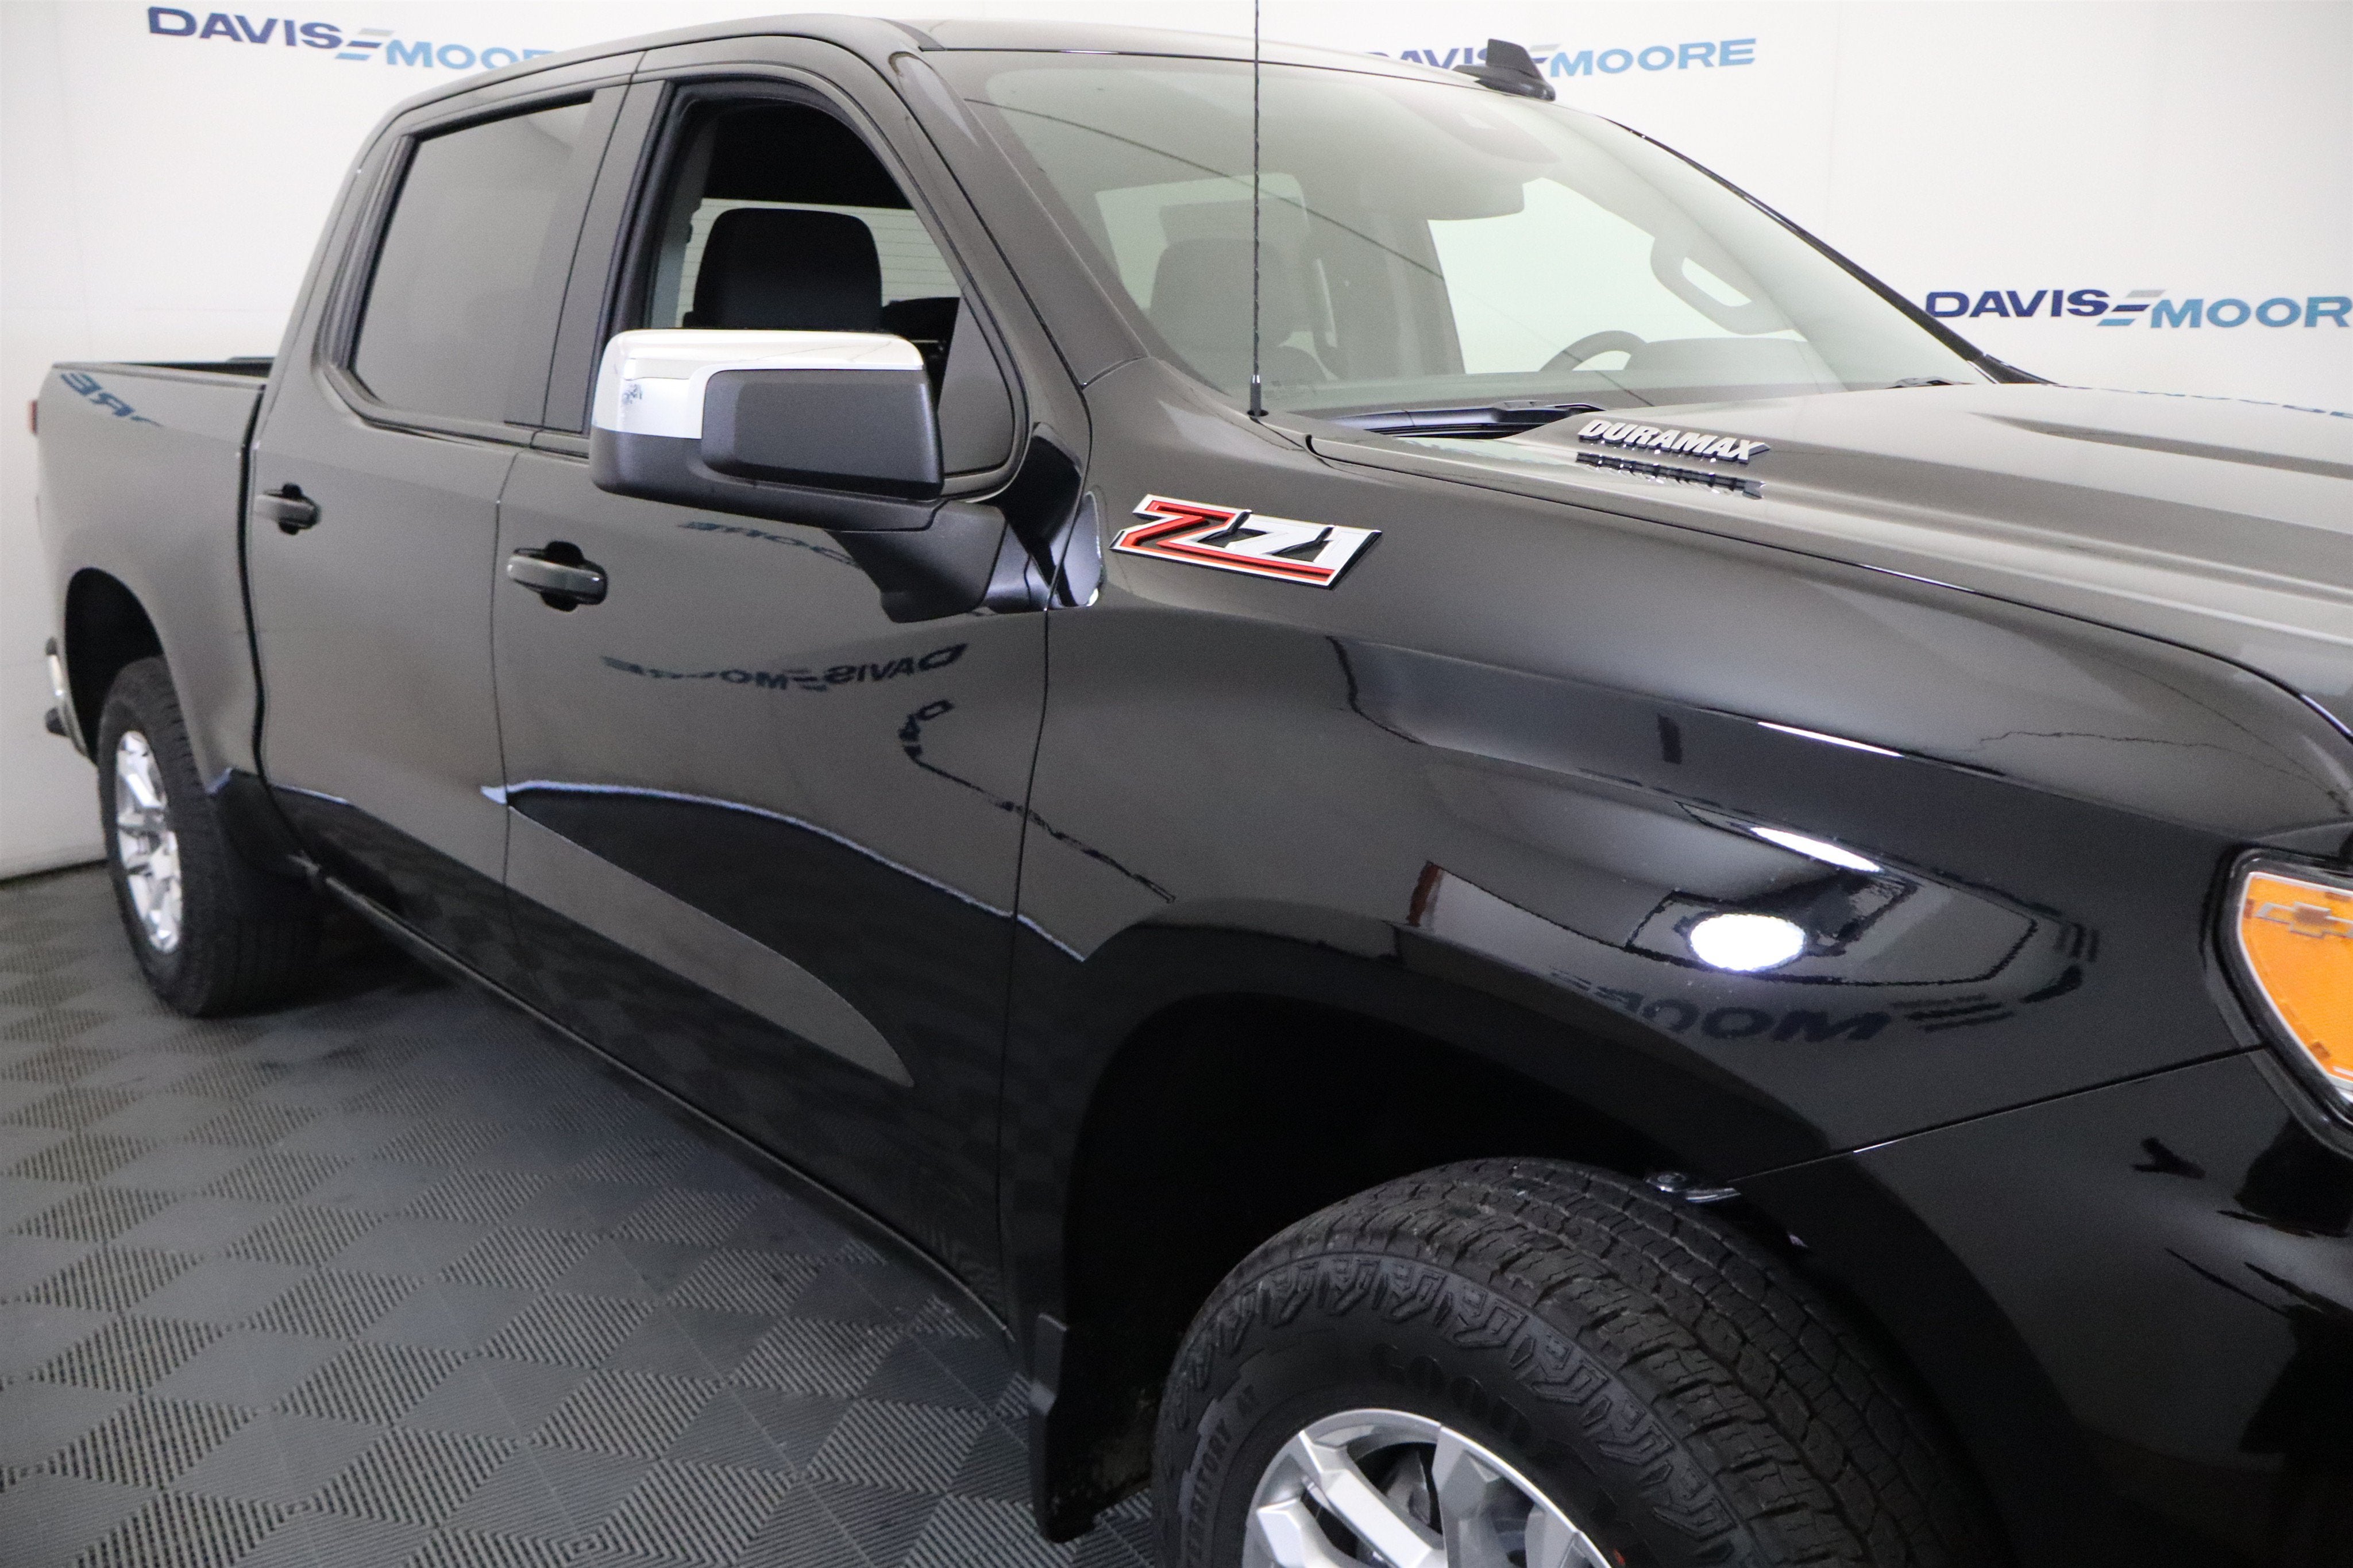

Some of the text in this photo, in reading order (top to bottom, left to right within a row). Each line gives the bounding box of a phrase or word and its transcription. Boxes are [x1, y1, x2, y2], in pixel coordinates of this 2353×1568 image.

[147, 6, 560, 69] DAVIS MOO
[1550, 37, 1756, 78] MOORE
[1925, 289, 2352, 328] DAVIS MOOR
[1577, 419, 1771, 464] DURAMAX
[1109, 493, 1382, 590] Z71
